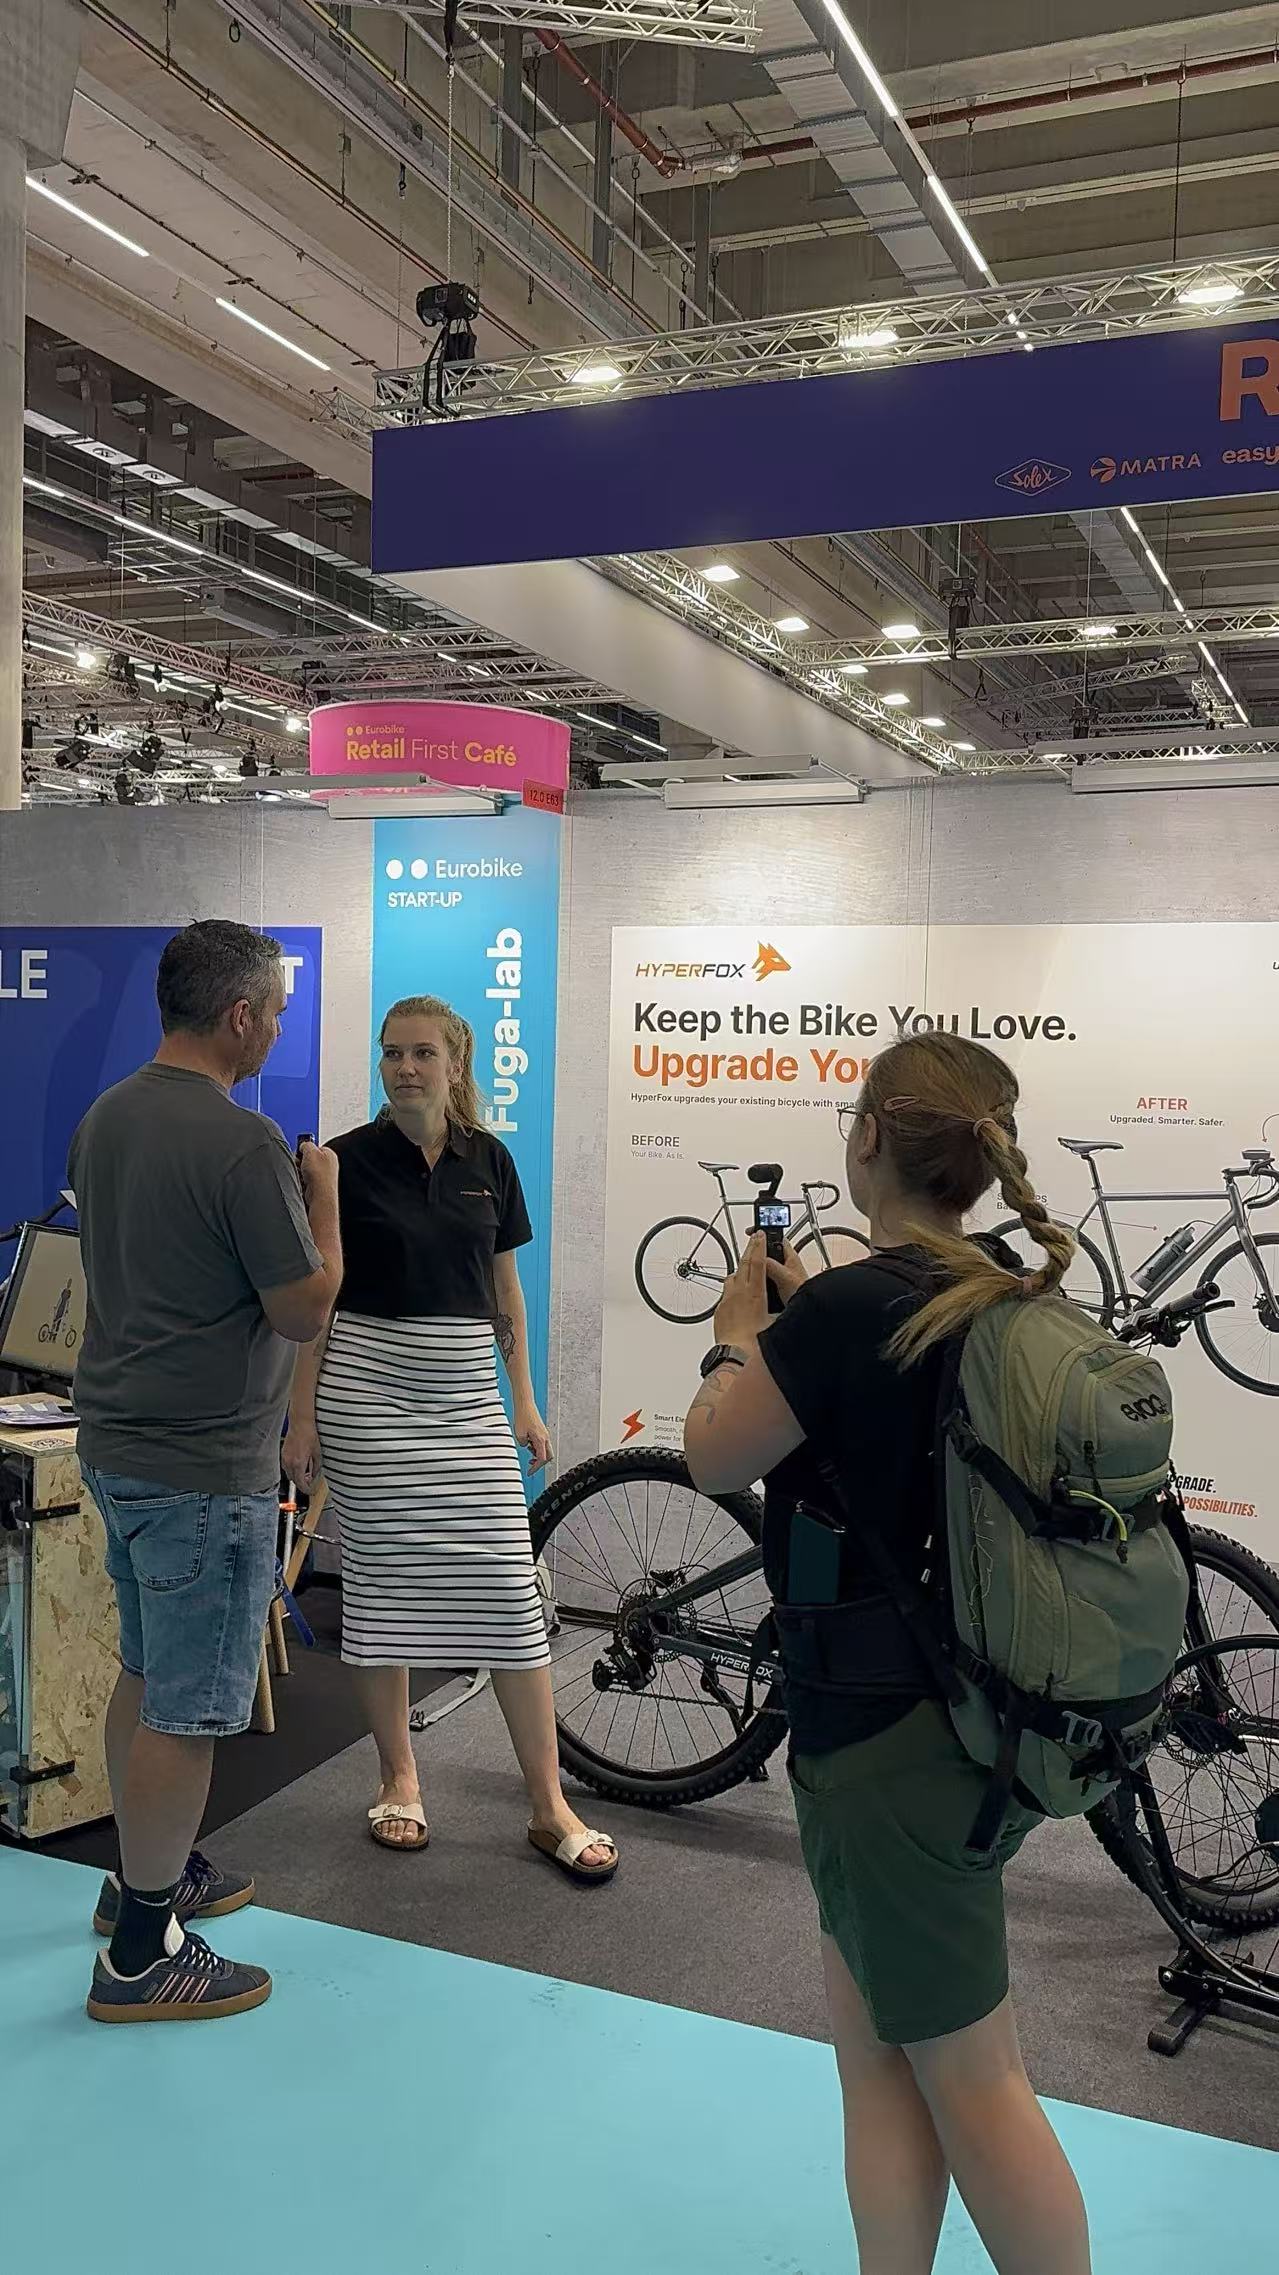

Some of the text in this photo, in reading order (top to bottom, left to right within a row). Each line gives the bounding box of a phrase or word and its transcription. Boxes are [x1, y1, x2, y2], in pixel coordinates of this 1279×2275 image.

[1120, 453, 1201, 476] MATRA
[365, 725, 405, 734] Eurobike
[346, 738, 517, 766] Retail First Café
[435, 857, 523, 878] Eurobike
[387, 891, 463, 909] START-UP
[635, 963, 746, 979] HYPERFOX
[484, 927, 528, 1133] Fuga-lab
[635, 1003, 1077, 1041] Keep the Bike You Love.
[633, 1045, 798, 1087] Upgrade
[630, 1092, 672, 1103] HyperFox
[674, 1094, 716, 1105] upgrades
[718, 1096, 738, 1106] your
[739, 1097, 776, 1108] existing
[777, 1098, 811, 1109] bicycle
[812, 1100, 833, 1108] with
[1136, 1097, 1188, 1111] AFTER
[1158, 1116, 1197, 1126] Smarter.
[631, 1135, 680, 1147] BEFORE
[654, 1414, 674, 1422] Smart
[710, 1653, 773, 1679] HYPEROX
